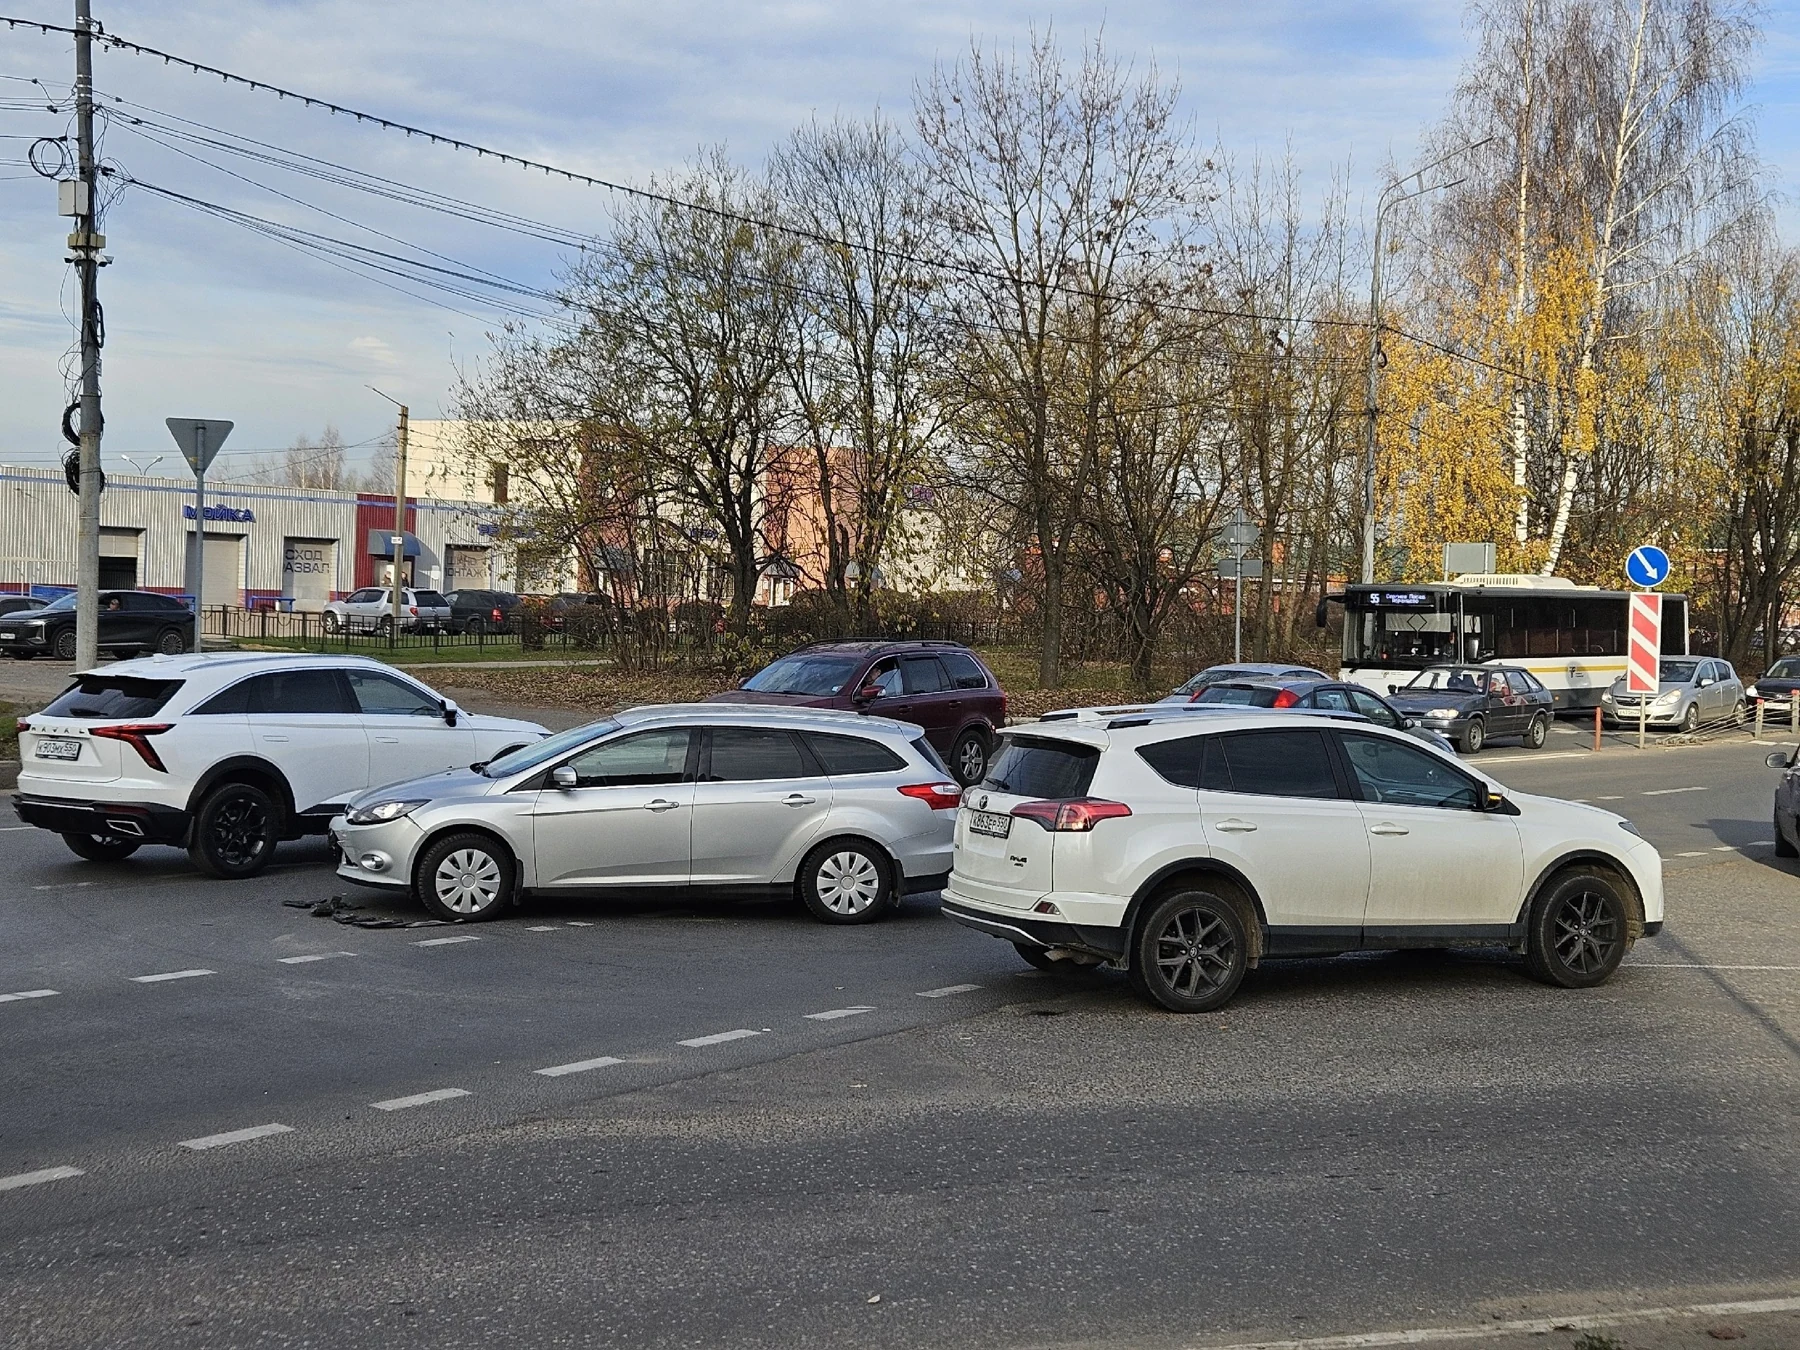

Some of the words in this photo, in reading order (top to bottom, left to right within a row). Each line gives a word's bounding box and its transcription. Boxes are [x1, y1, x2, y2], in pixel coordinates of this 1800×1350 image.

[182, 503, 256, 523] МОЙКА
[285, 549, 323, 561] СХОД
[283, 562, 330, 573] АЗВАЛ
[445, 567, 485, 579] ОНТАЖ
[1370, 593, 1380, 604] 55
